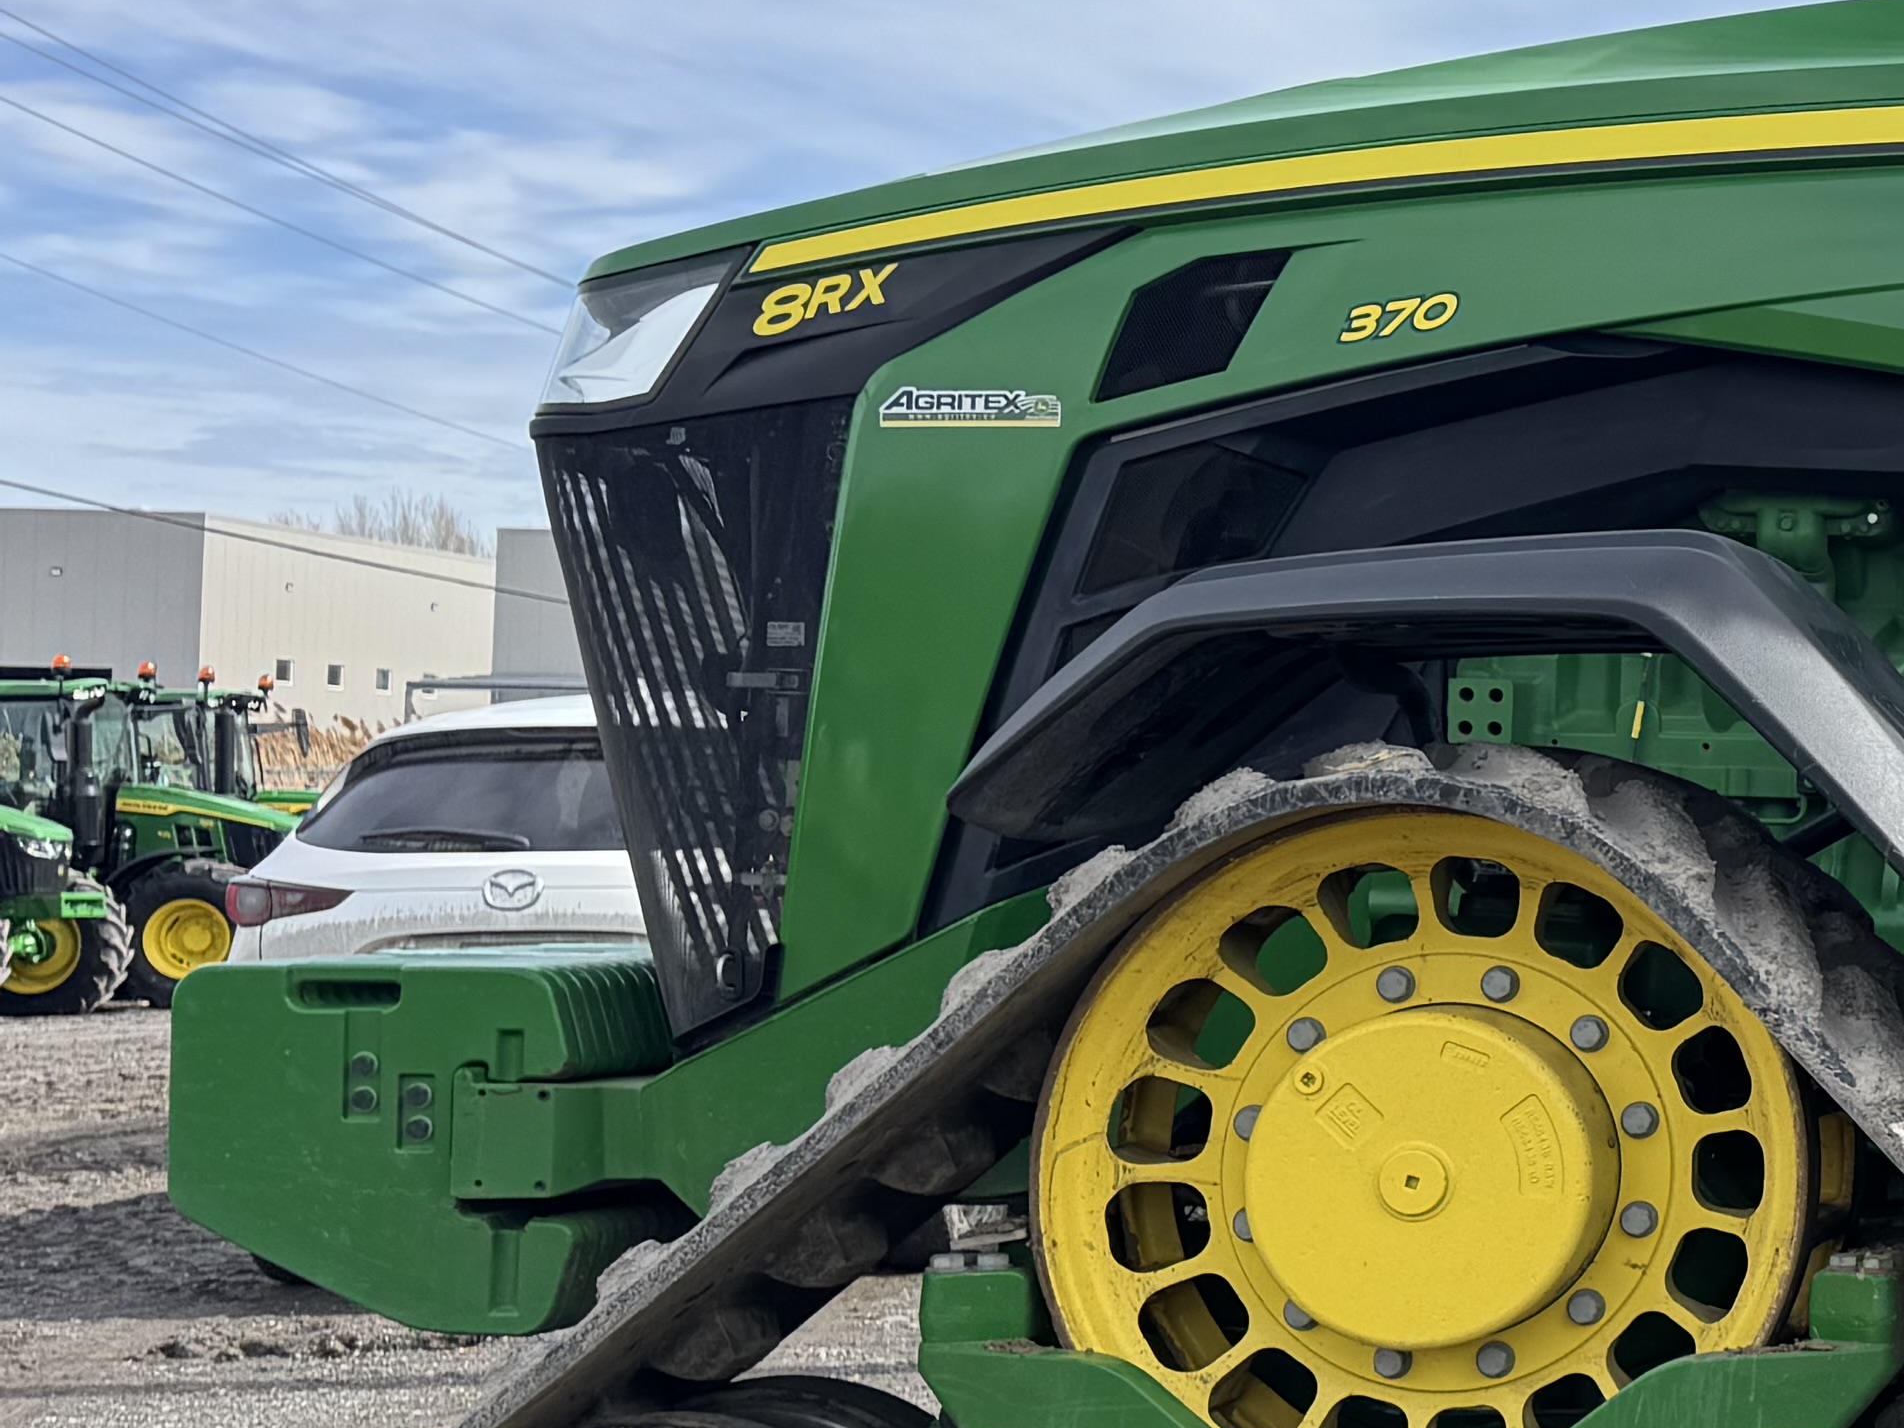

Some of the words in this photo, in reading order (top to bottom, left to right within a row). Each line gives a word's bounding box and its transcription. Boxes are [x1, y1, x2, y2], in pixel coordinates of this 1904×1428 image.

[753, 262, 899, 336] 8RX
[1339, 292, 1459, 343] 370
[883, 390, 1022, 411] AGRITEX
